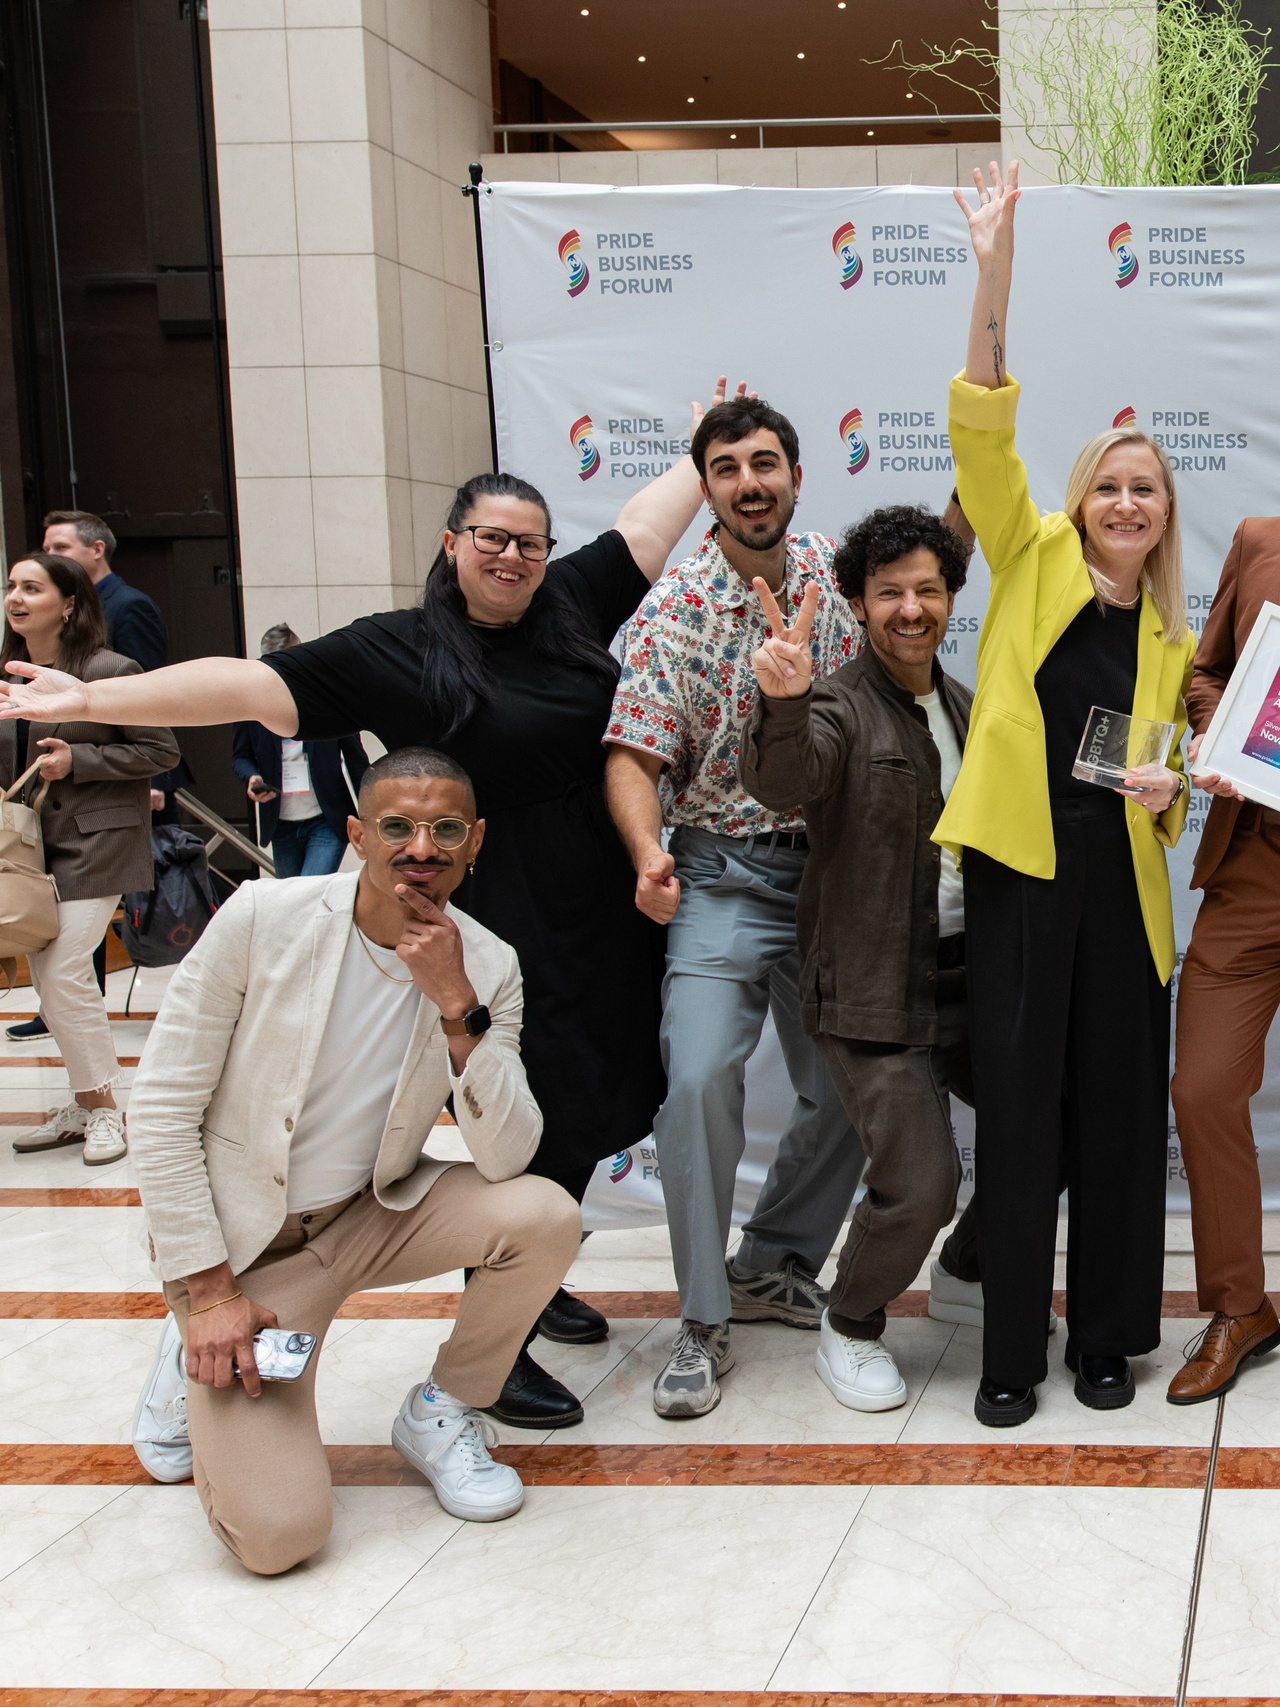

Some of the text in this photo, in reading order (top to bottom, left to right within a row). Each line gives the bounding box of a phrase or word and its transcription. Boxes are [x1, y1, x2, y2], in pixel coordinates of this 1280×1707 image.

[872, 224, 929, 241] PRIDE
[1148, 227, 1207, 244] PRIDE
[596, 233, 654, 249] PRIDE
[598, 254, 694, 272] BUSINESS
[872, 247, 968, 264] BUSINESS
[1148, 249, 1245, 265] BUSINESS
[600, 278, 673, 295] FORUM
[873, 270, 946, 287] FORUM
[1149, 271, 1224, 287] FORUM
[608, 418, 664, 434] PRIDE
[878, 412, 935, 427] PRIDE
[1152, 411, 1210, 426] PRIDE
[609, 439, 691, 456] BUSINES
[879, 434, 951, 450] BUSINE
[1153, 433, 1248, 449] BUSINESS
[610, 462, 673, 478] FORU
[880, 456, 952, 472] FORUM
[1167, 455, 1226, 471] ORUM
